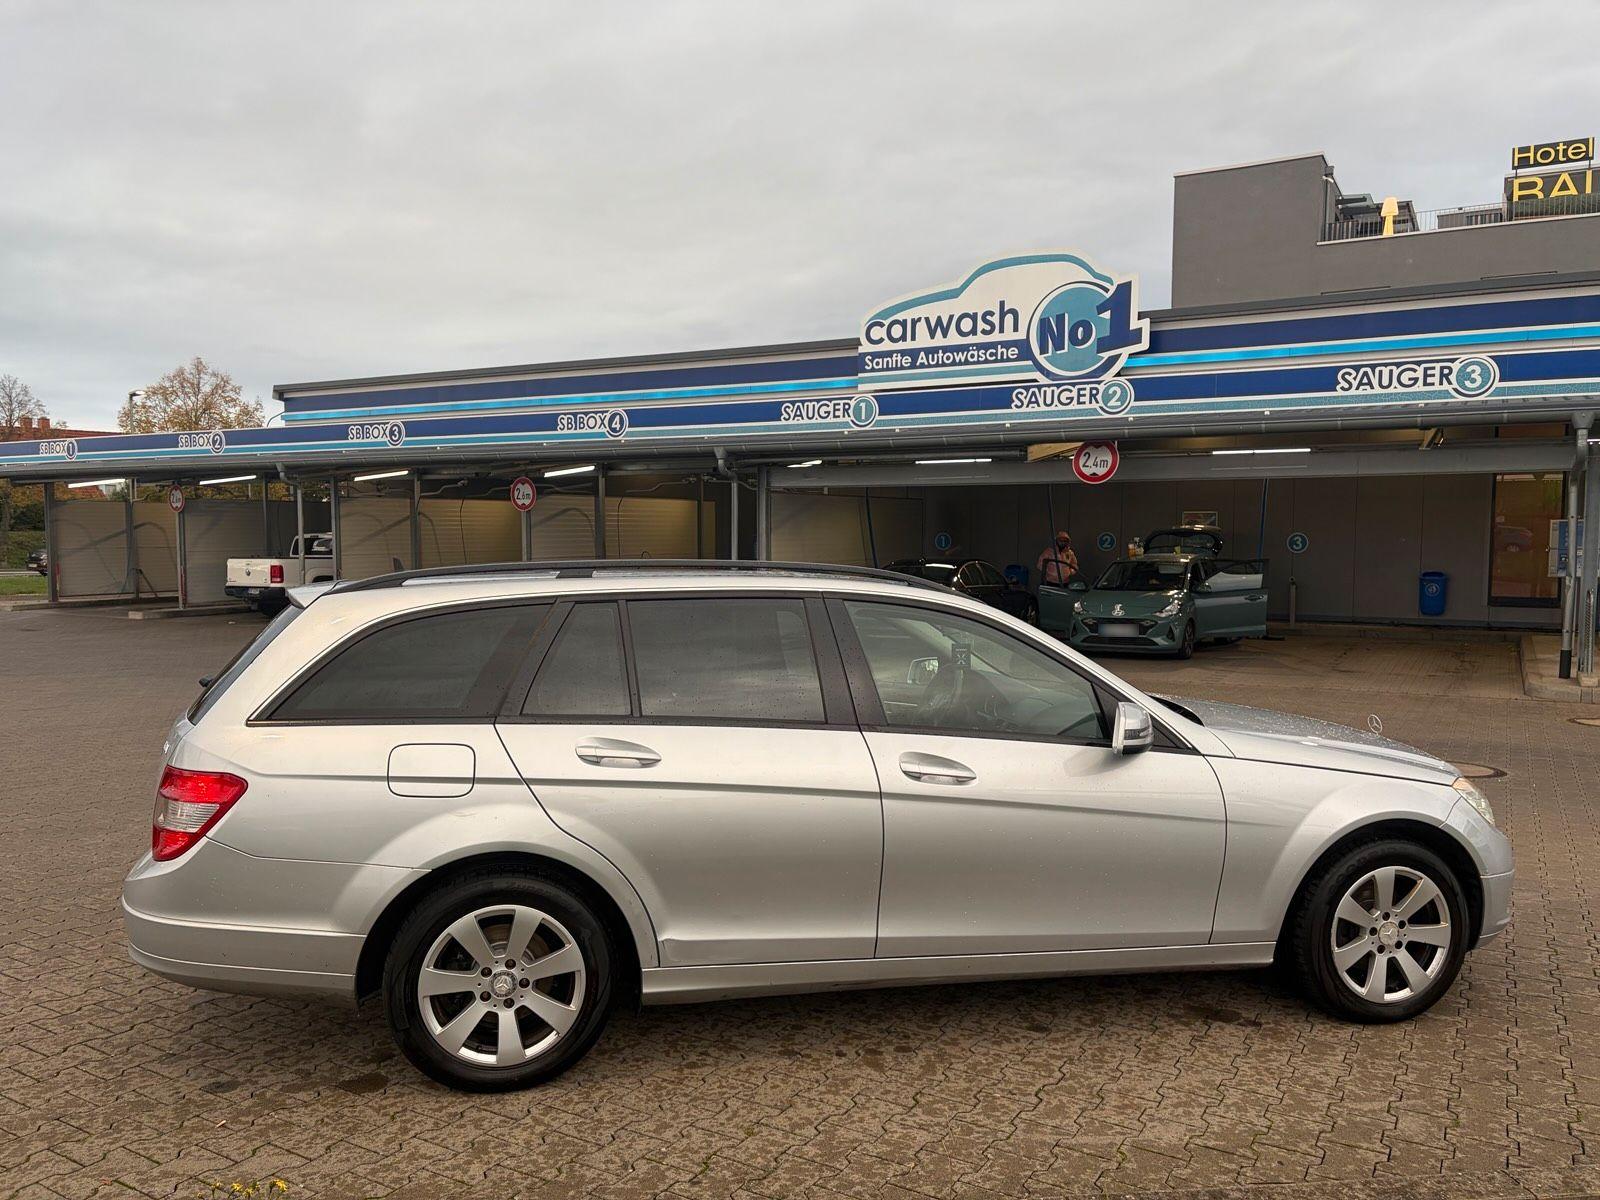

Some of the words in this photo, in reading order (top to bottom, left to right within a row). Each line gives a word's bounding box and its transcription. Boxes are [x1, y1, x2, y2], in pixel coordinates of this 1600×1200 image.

[1514, 137, 1593, 167] Hotel
[865, 300, 1019, 345] carwash
[1039, 312, 1095, 356] No
[1095, 280, 1142, 356] 1
[864, 352, 912, 369] Sanfte
[916, 346, 1019, 366] Autowäsche
[1339, 365, 1453, 392] SAUGER
[1464, 364, 1482, 388] 3
[1013, 386, 1100, 409] SAUGER
[1107, 386, 1121, 406] 2
[783, 402, 851, 421] SAUGER
[349, 427, 361, 440] SB
[365, 426, 388, 439] BOX
[391, 426, 399, 440] 3
[559, 416, 574, 431] SB
[579, 415, 607, 430] BOX
[611, 414, 621, 431] 4
[40, 443, 49, 455] SB
[51, 443, 66, 454] BOX
[179, 436, 190, 448] SB
[192, 435, 211, 447] BOX
[1293, 536, 1303, 550] 3
